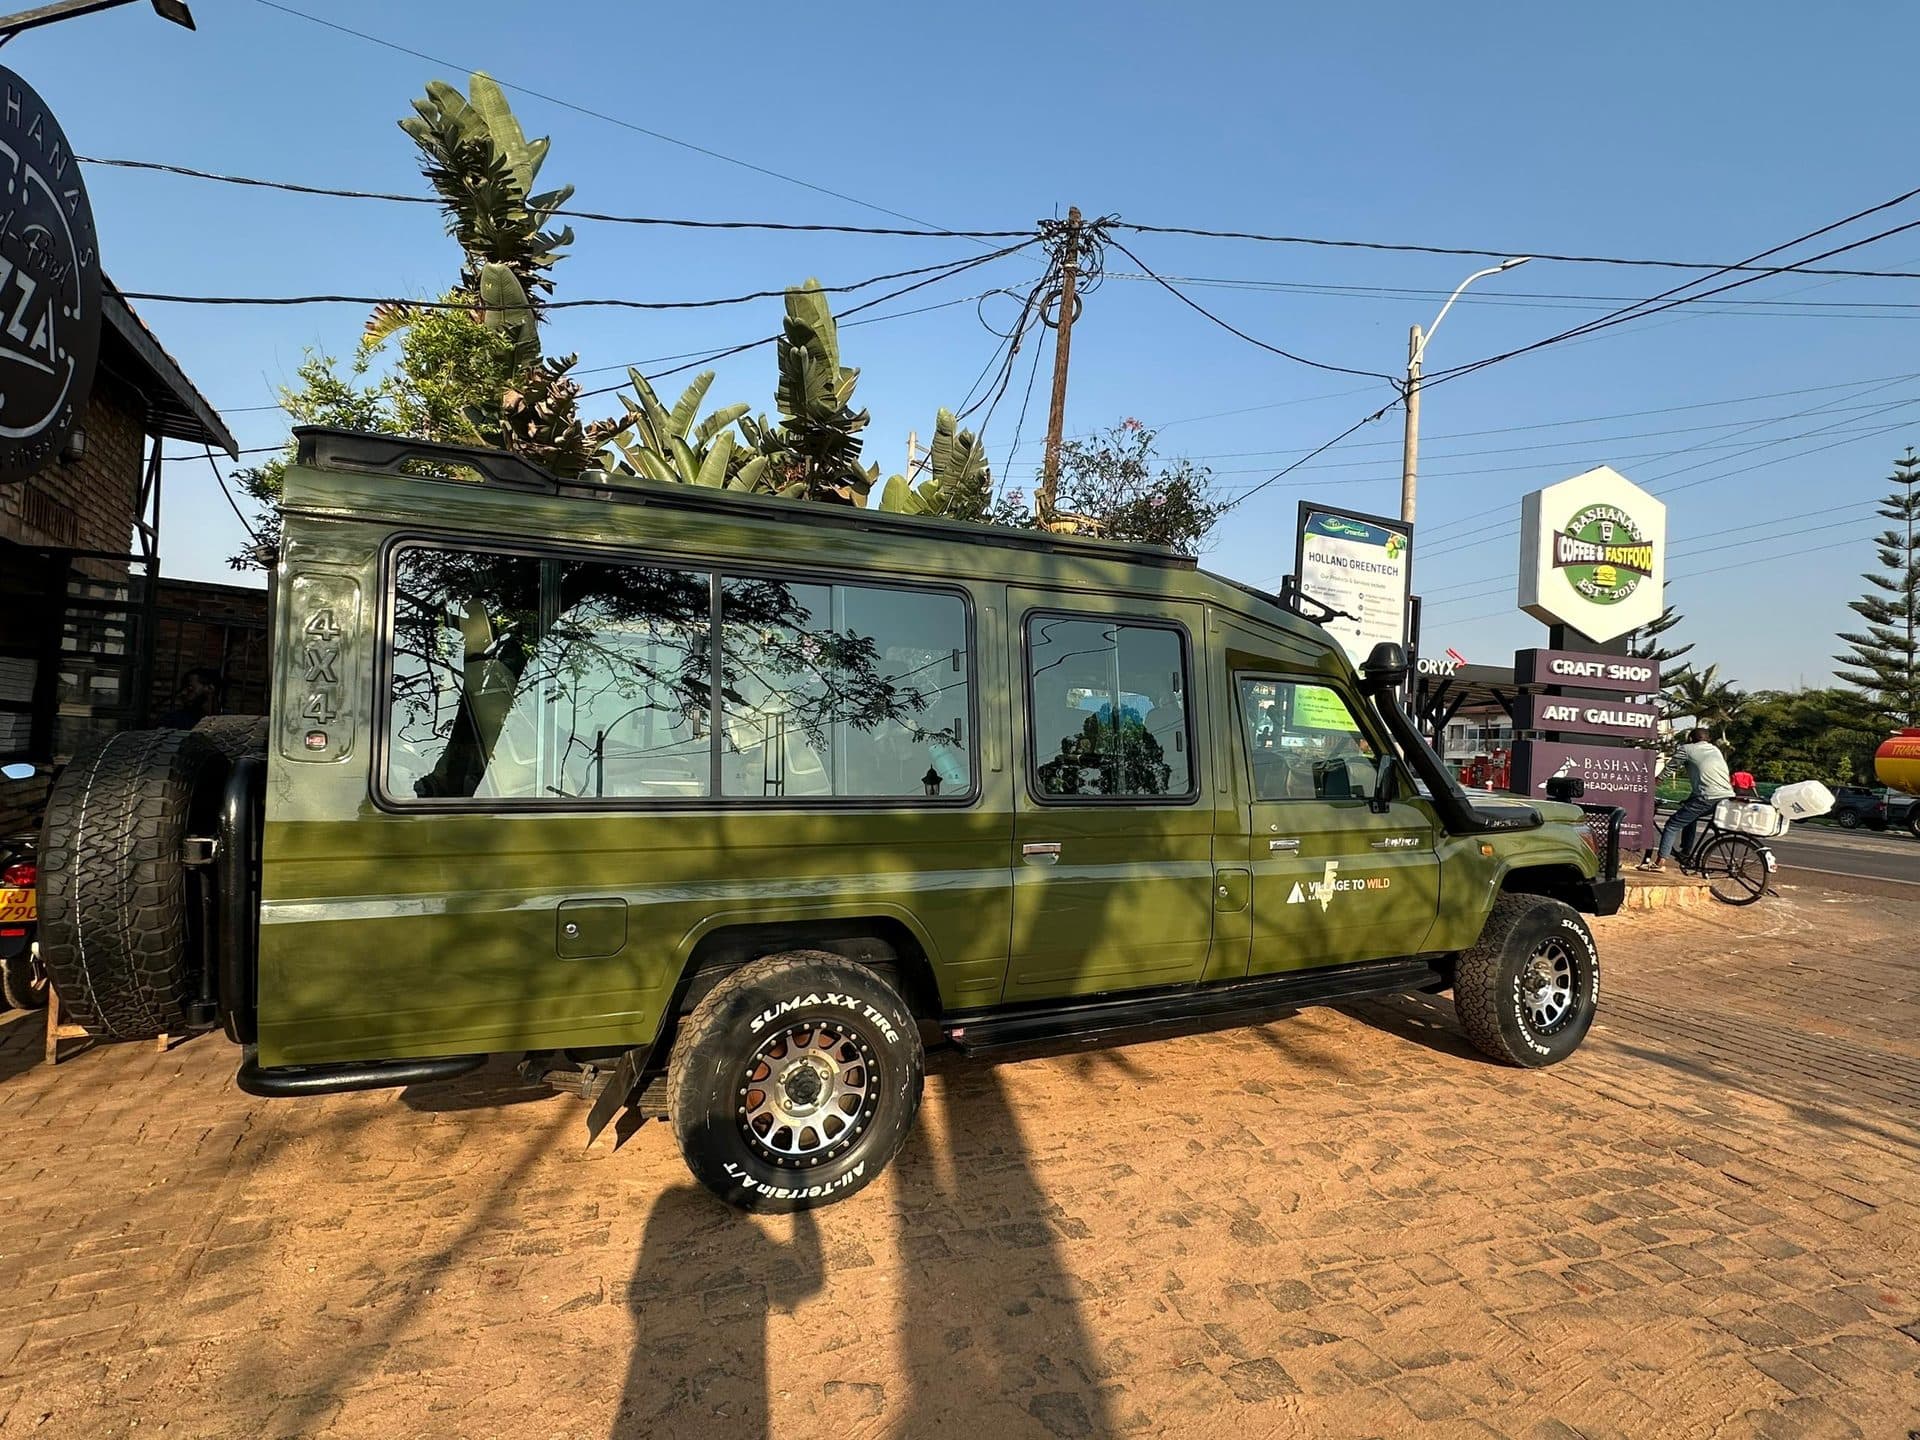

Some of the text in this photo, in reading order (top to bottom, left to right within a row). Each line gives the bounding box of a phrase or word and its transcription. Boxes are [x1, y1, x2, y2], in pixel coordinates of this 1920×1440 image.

[1308, 551, 1399, 576] HOLLAND GREENTECH
[1559, 536, 1652, 570] COFFEE & FASTFOOD
[1612, 579, 1637, 599] 2018
[1416, 659, 1456, 677] ORYX
[1551, 659, 1652, 682] CRAFT SHOP
[1544, 705, 1655, 729] ART GALLERY
[1584, 757, 1649, 774] BASHANA
[1584, 771, 1649, 783] COMPANIES
[1583, 781, 1649, 794] HEADQUARTERS
[1308, 877, 1391, 894] VIAGE TO WILD
[1561, 919, 1600, 1005] SUMAXX TIRE
[750, 992, 900, 1044] SUMAXX TIRE
[722, 1160, 866, 1199] All-Terrain A/T
